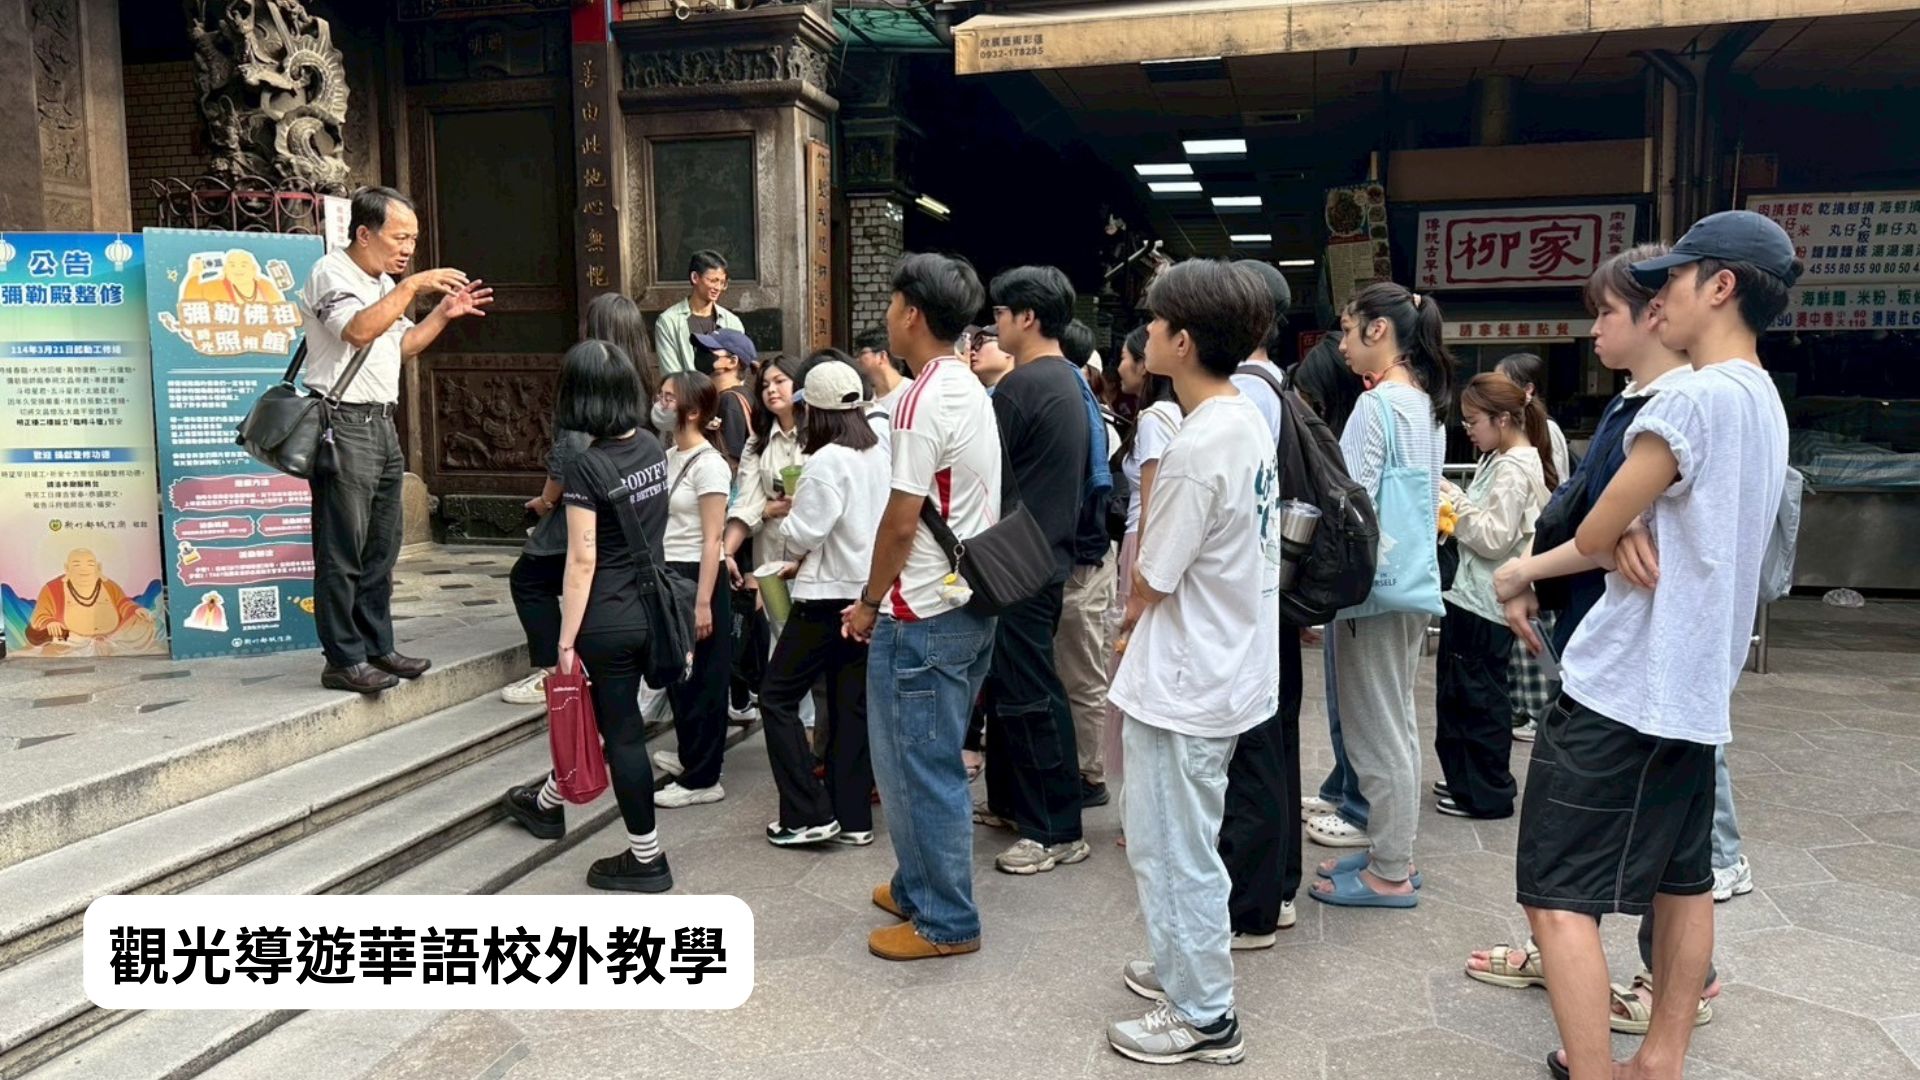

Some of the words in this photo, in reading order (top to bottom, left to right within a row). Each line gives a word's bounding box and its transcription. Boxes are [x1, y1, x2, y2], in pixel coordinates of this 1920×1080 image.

[1421, 217, 1441, 287] 傳統古早味
[1453, 221, 1586, 275] 柳家
[28, 250, 93, 277] 公告
[1809, 264, 1822, 275] 45
[1824, 263, 1836, 274] 55
[1838, 263, 1850, 274] 80
[1853, 262, 1865, 274] 55
[1869, 262, 1881, 274] 90
[1883, 262, 1896, 273] 80
[1898, 262, 1911, 273] 50
[1, 282, 124, 306] 彌勒殿整修
[1858, 289, 1887, 305] 米粉
[181, 301, 298, 326] 彌勒佛祖
